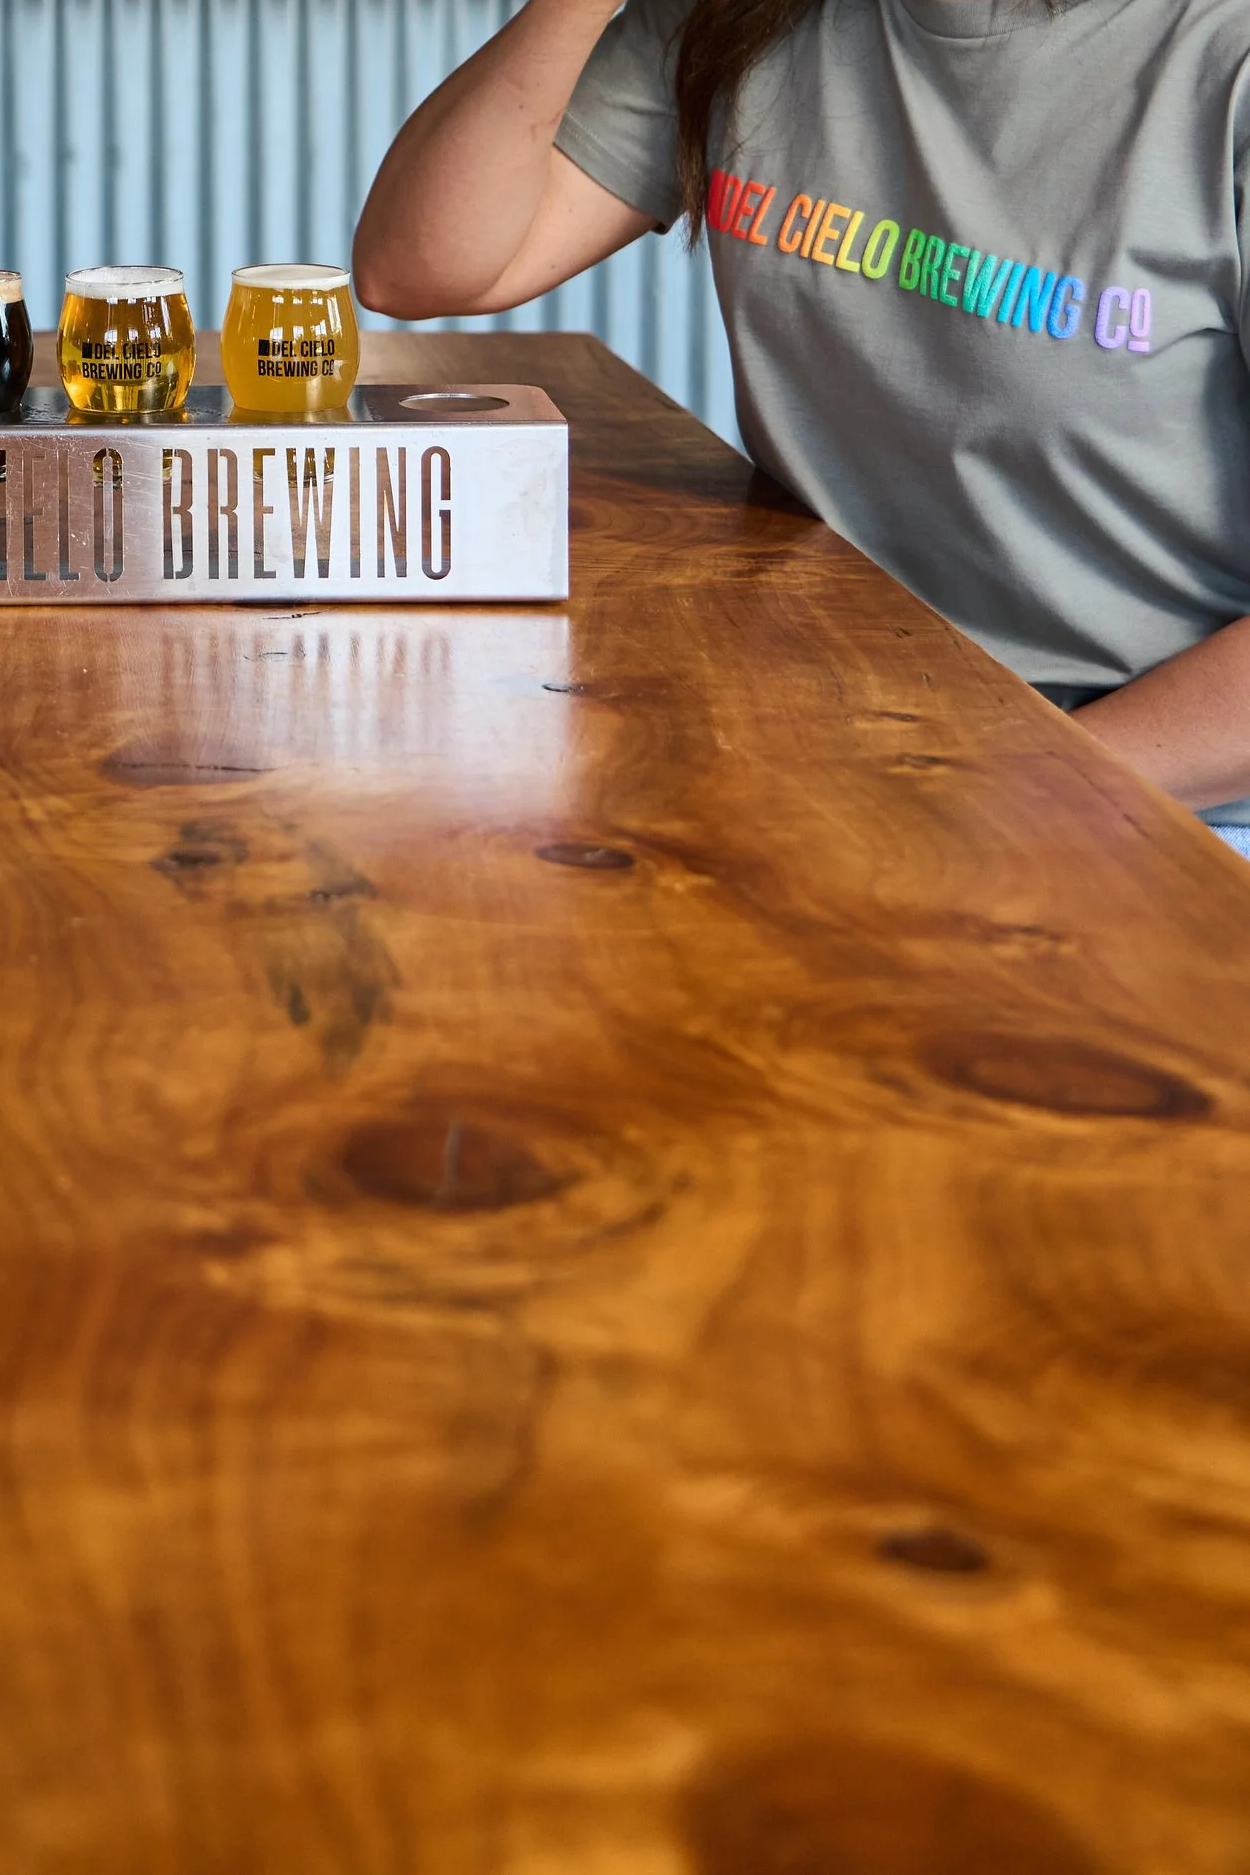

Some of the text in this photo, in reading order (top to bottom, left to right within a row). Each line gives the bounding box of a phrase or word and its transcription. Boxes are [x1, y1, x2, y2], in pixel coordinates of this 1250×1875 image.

[718, 172, 778, 246] DEL
[777, 193, 900, 280] CIELO
[898, 228, 1086, 340] BREWING
[94, 341, 119, 360] DEL
[271, 339, 297, 357] DEL
[81, 361, 141, 379] BREWING
[258, 360, 318, 377] BREWING
[161, 445, 452, 581] BREWING
